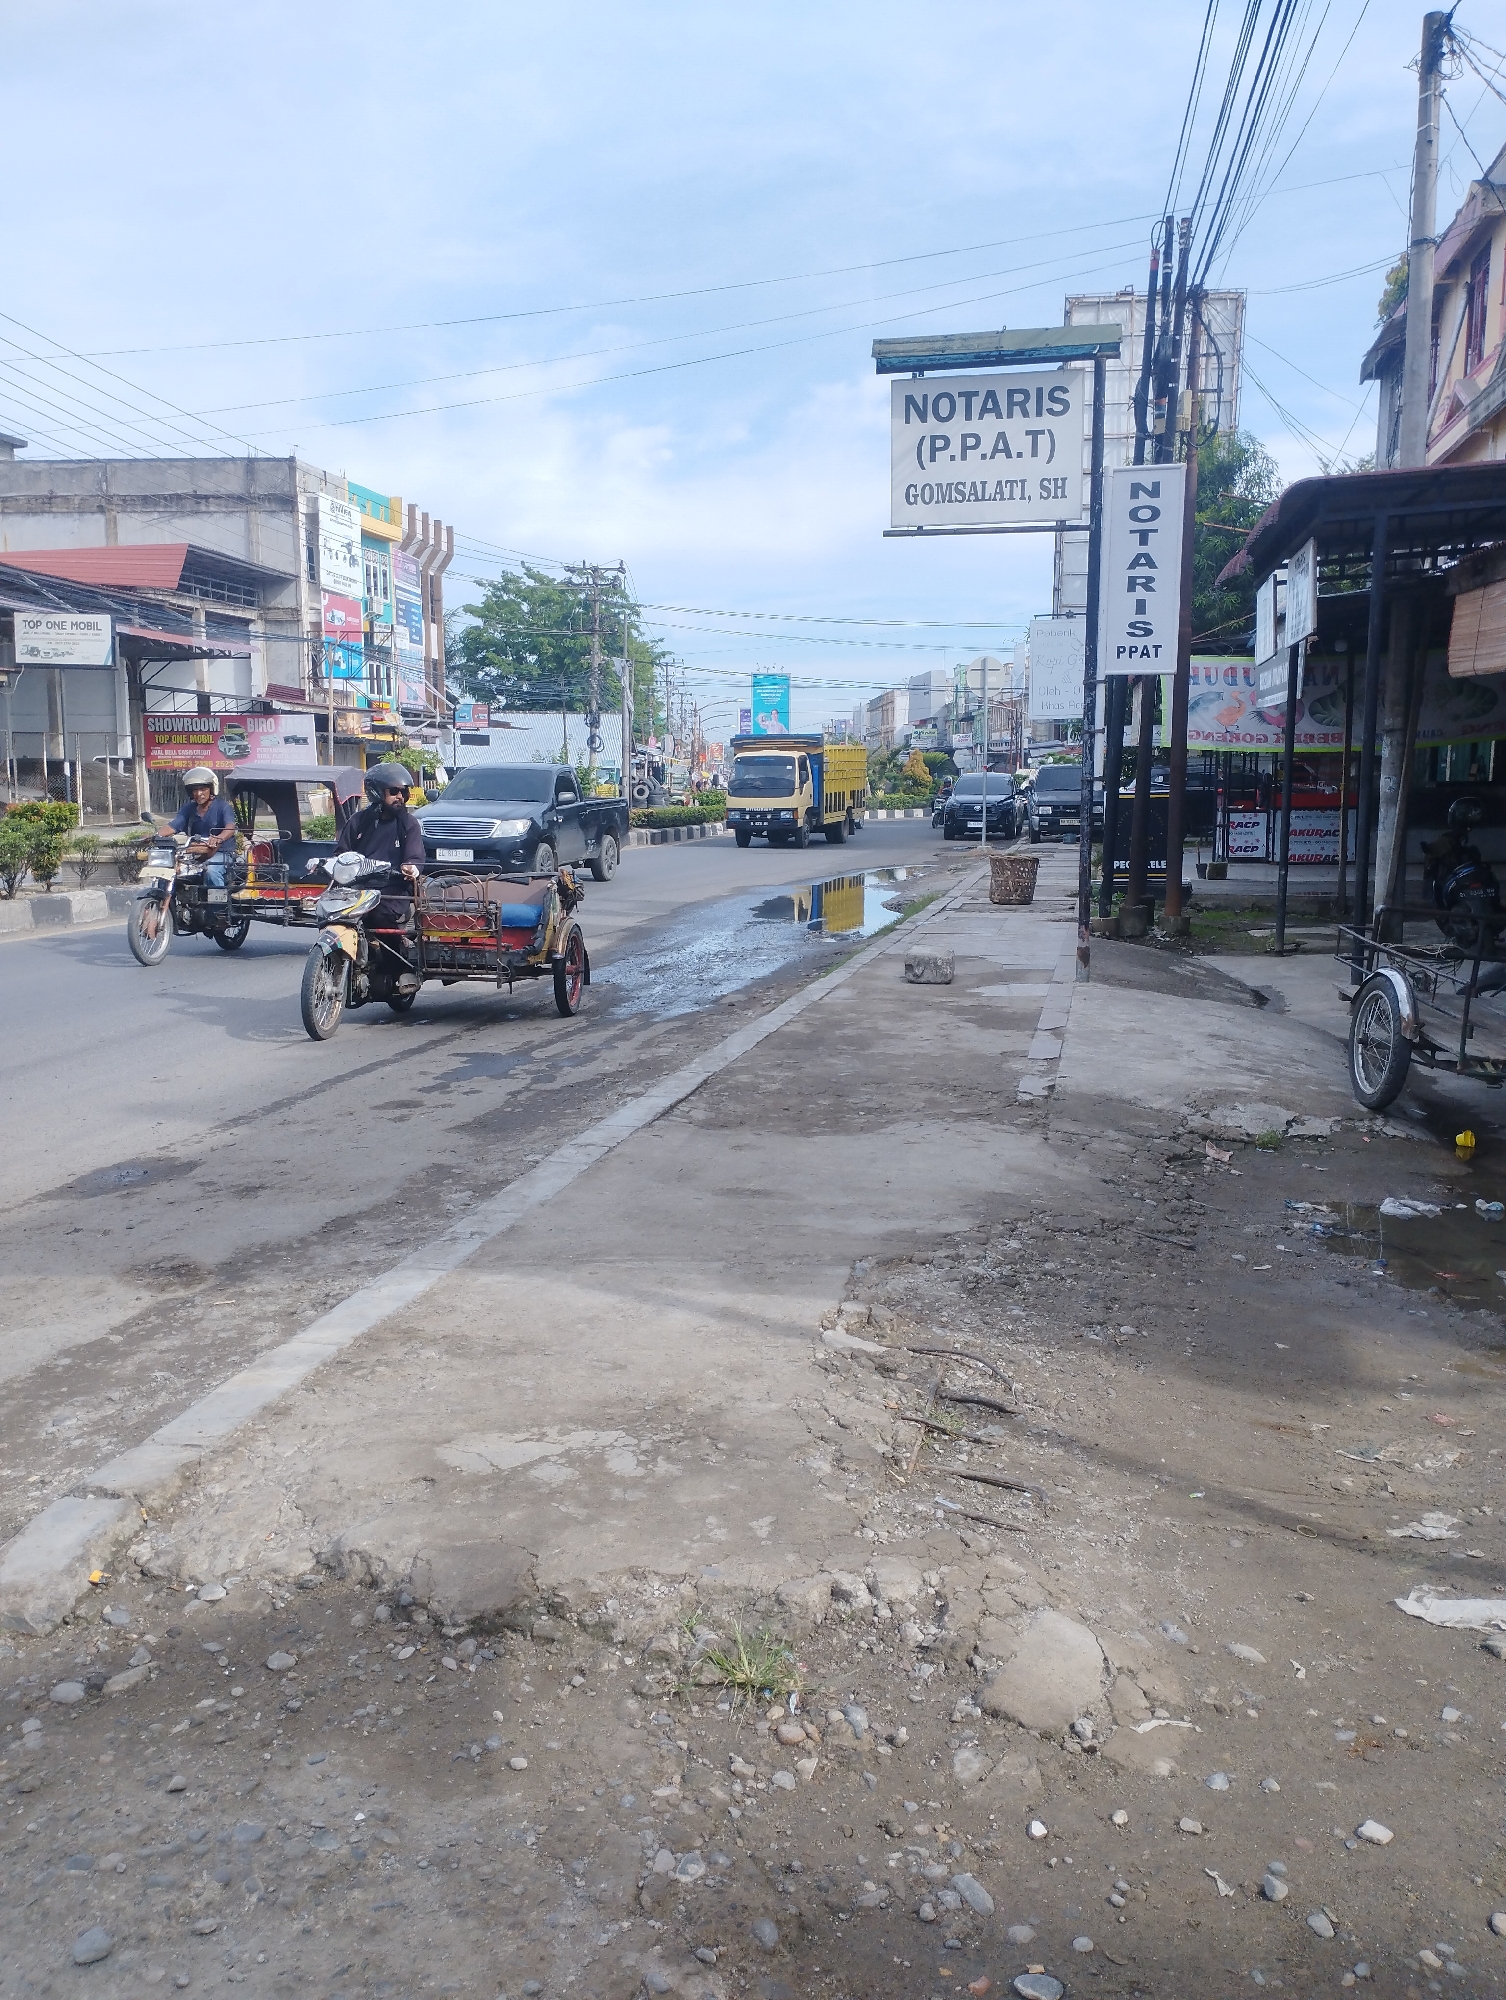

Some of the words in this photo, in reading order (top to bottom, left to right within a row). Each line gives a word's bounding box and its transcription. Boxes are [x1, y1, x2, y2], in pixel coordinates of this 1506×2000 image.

[904, 385, 1071, 425] NOTARIS
[916, 429, 1056, 470] (P.P.A.T)
[904, 479, 1032, 506] GOMSALATI,
[1039, 476, 1068, 501] SH
[1126, 481, 1161, 638] NOTARIS
[22, 619, 42, 630] TOP
[46, 620, 67, 630] ONE
[70, 621, 102, 631] MOBIL
[1116, 644, 1163, 659] PPAT
[1041, 700, 1064, 710] Khas
[147, 717, 221, 732] SHOWROOM
[246, 717, 276, 733] BIRO
[279, 718, 311, 733] JASA
[154, 734, 171, 744] TOP
[171, 734, 188, 744] ONE
[189, 734, 215, 744] MOBIL
